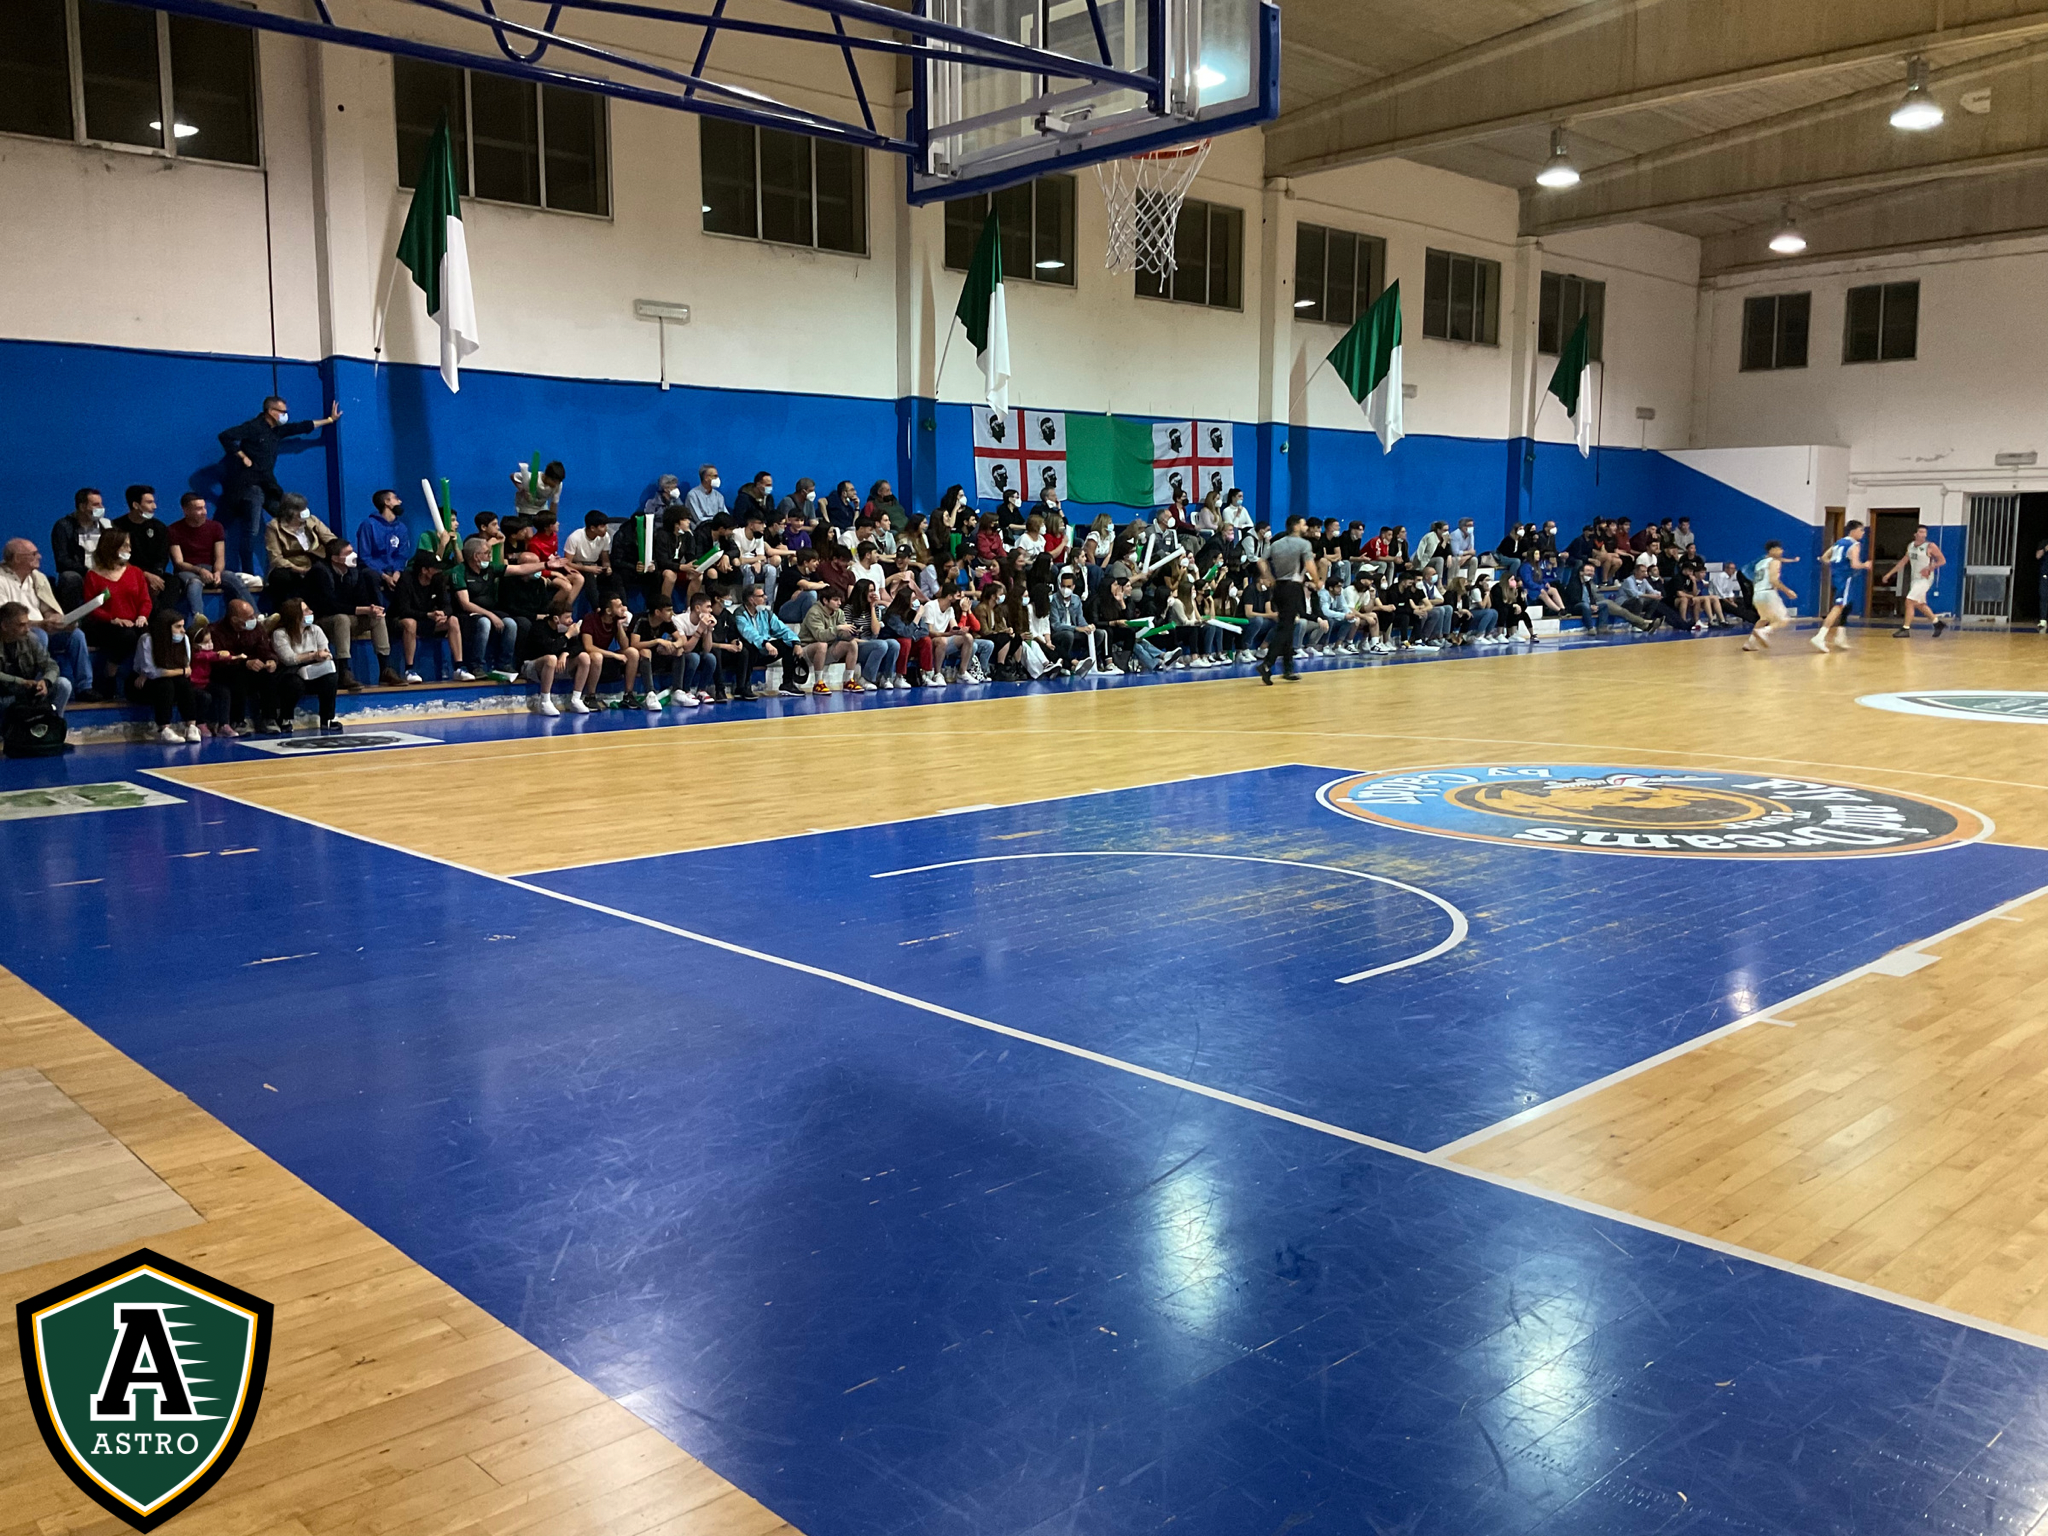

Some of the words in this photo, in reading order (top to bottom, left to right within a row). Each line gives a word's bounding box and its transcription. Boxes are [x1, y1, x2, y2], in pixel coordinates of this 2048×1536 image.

[1487, 767, 1553, 778] by
[1335, 773, 1479, 804] Caddy
[1731, 778, 1873, 802] Fly
[1717, 810, 1813, 830] Tour
[1819, 805, 1930, 834] and
[1511, 827, 1905, 850] Dreams
